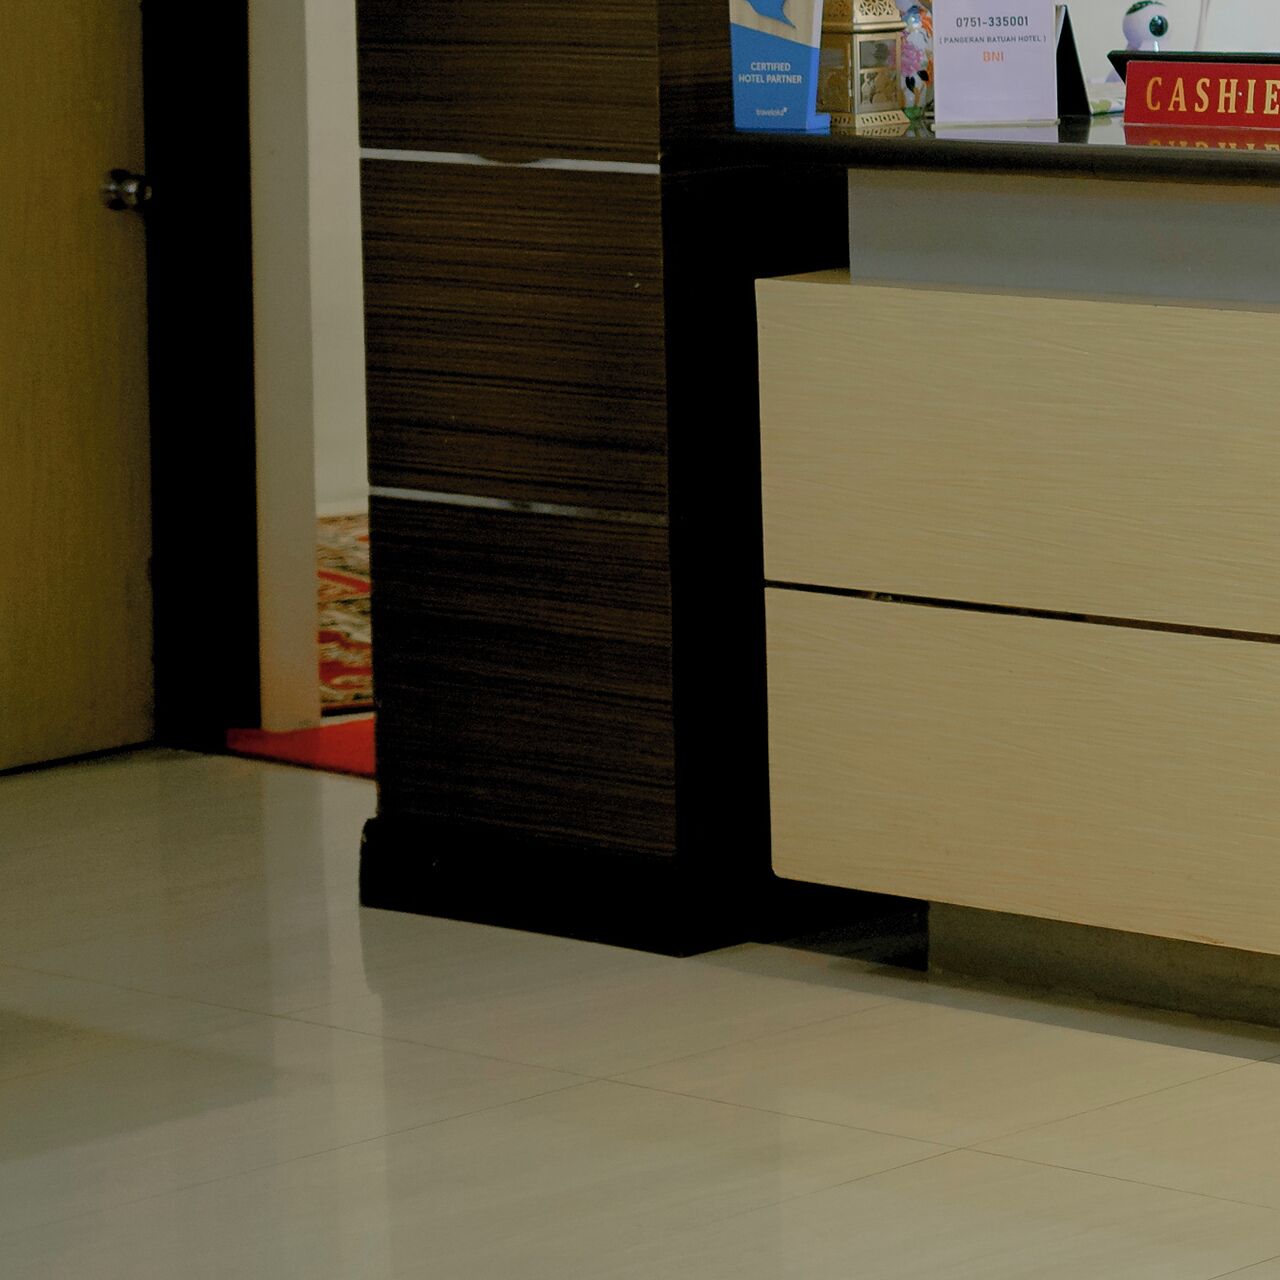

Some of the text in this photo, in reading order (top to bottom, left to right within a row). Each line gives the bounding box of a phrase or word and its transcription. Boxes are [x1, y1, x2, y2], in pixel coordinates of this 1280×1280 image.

[956, 15, 1029, 28] 0751-335001
[943, 36, 985, 44] PANGERAN
[982, 50, 1004, 62] BNI
[750, 62, 791, 72] CERTIFIED
[738, 73, 802, 84] HOTEL PARTNER
